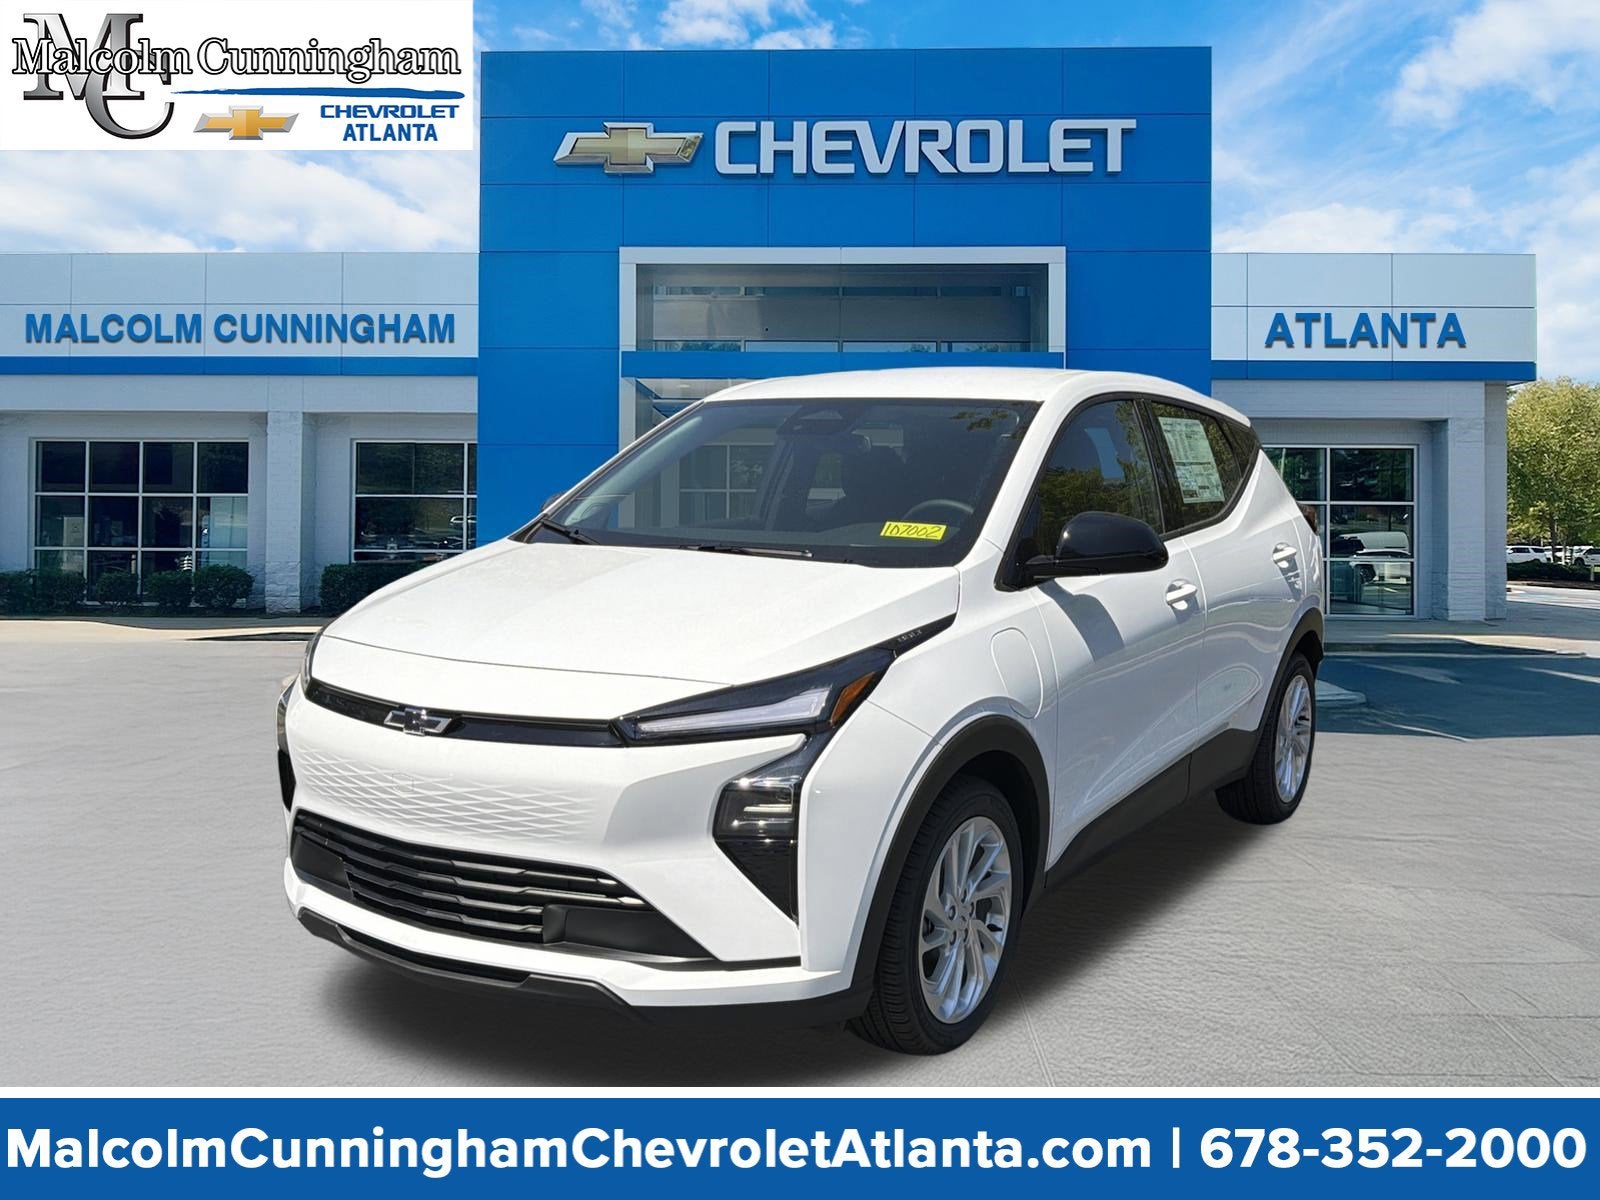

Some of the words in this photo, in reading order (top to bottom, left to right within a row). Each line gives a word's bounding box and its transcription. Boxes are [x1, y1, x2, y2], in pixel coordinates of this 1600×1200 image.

[714, 119, 1137, 175] CHEVROLET
[25, 313, 202, 344] MALCOLM
[213, 313, 456, 344] CUNNINGHAM
[1264, 312, 1467, 348] ATLANTA
